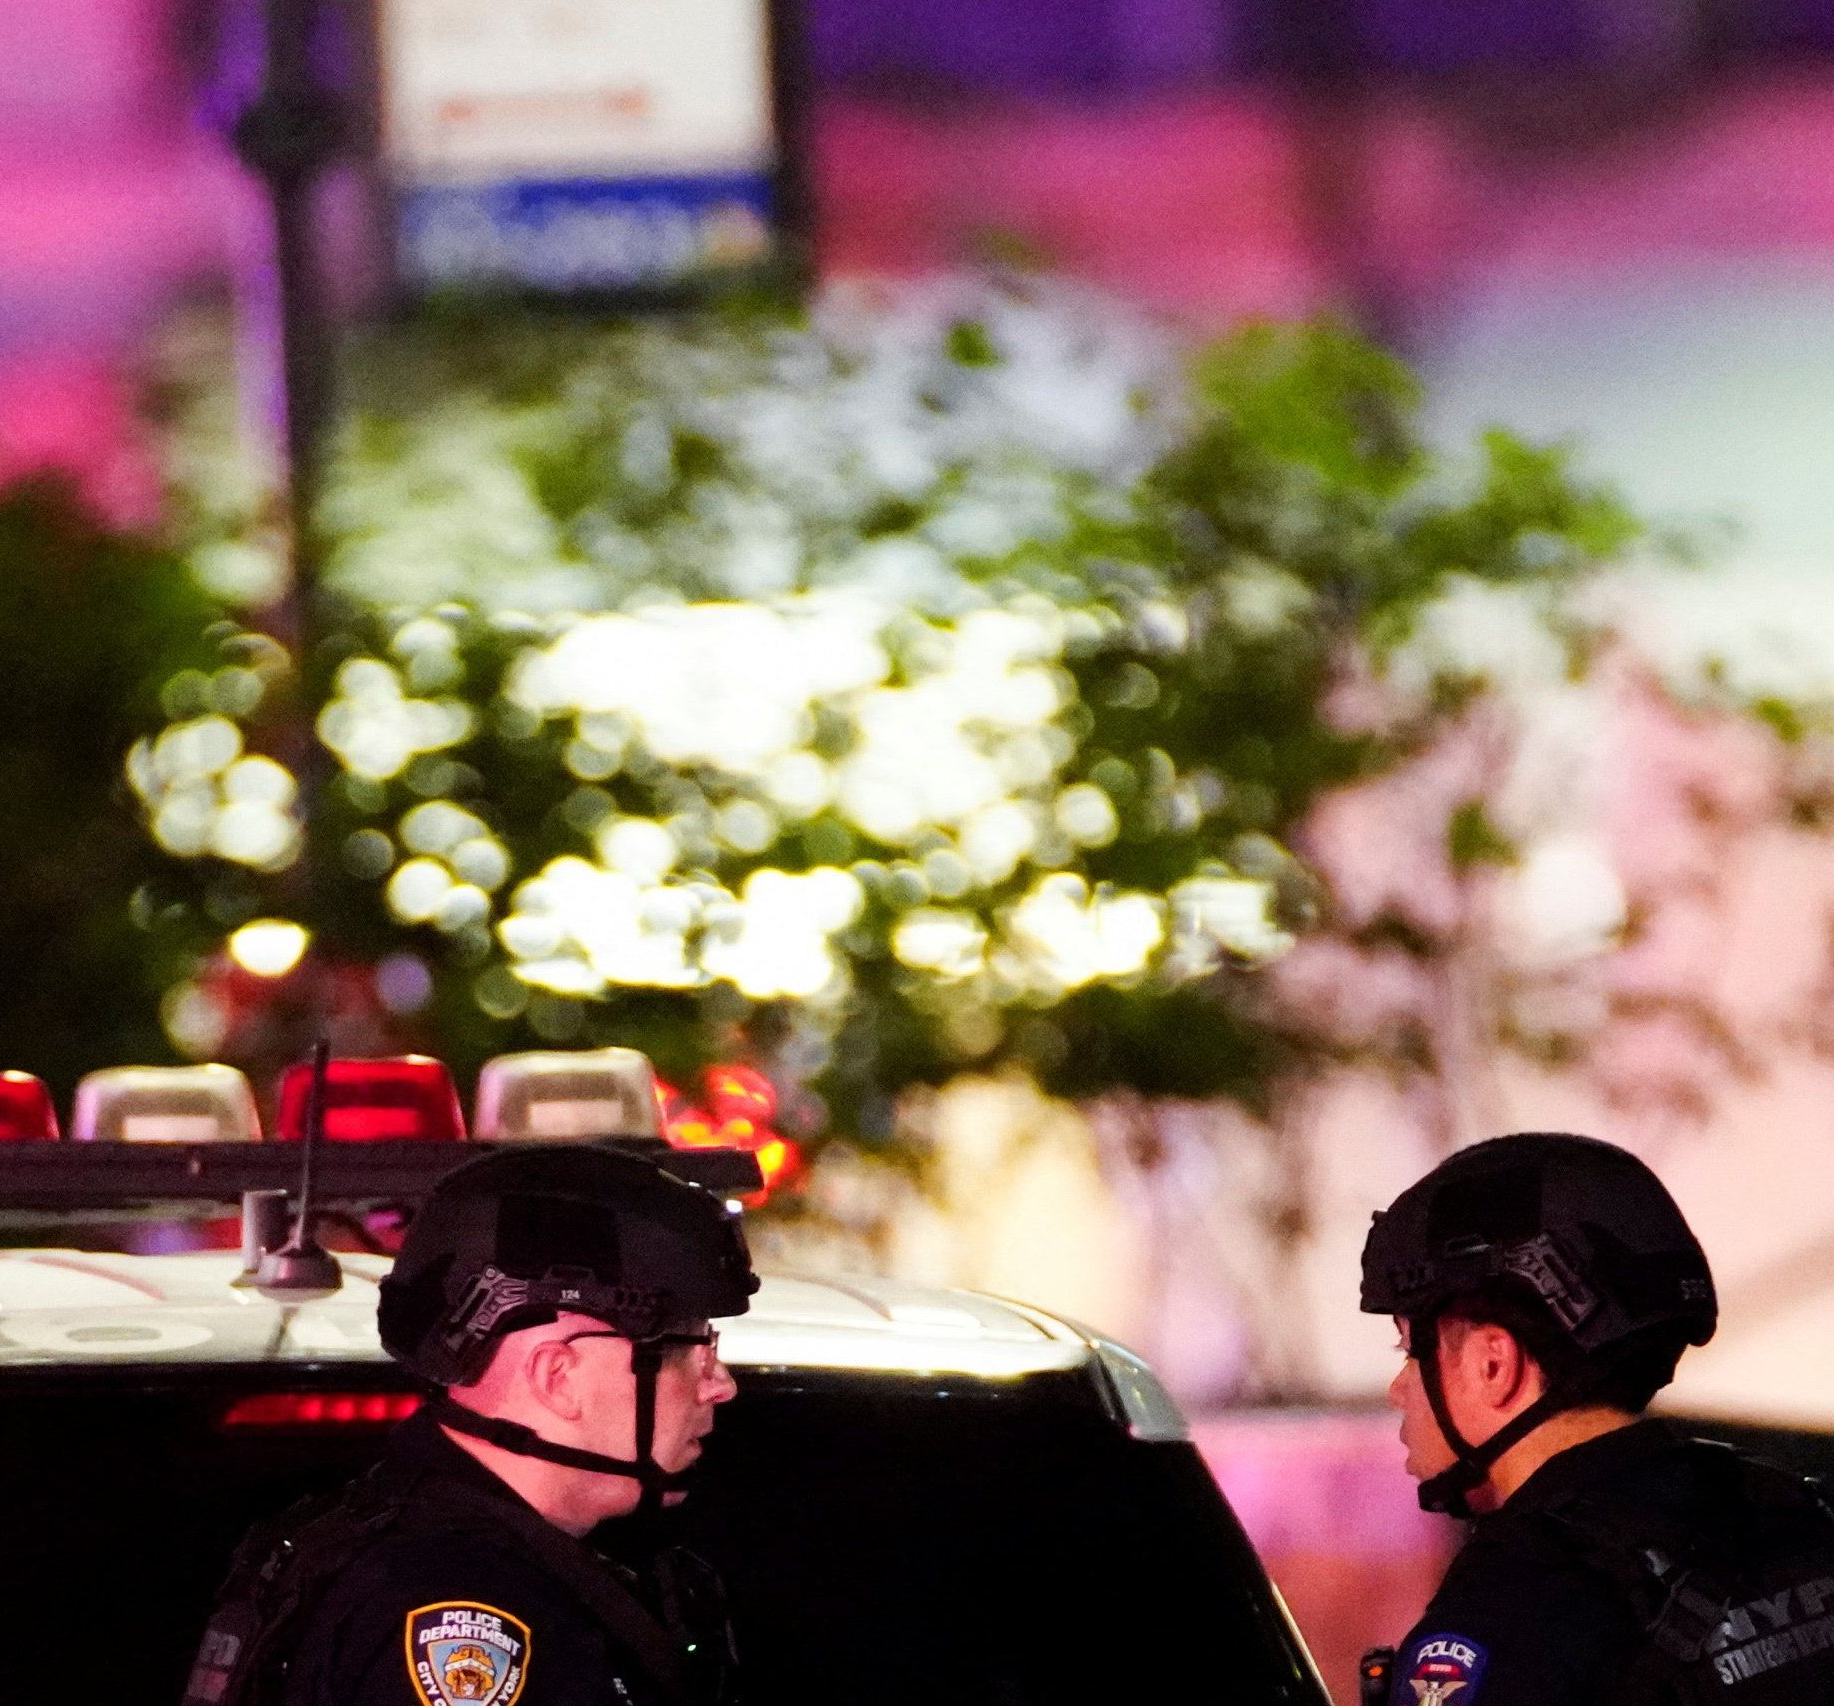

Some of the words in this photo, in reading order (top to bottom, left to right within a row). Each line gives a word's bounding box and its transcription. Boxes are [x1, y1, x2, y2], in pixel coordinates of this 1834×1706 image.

[442, 1610, 502, 1631] POLICE
[419, 1624, 521, 1656] DEPARTMENT
[1416, 1640, 1477, 1669] POLICE
[417, 1661, 439, 1695] CITY
[498, 1665, 521, 1701] YORK
